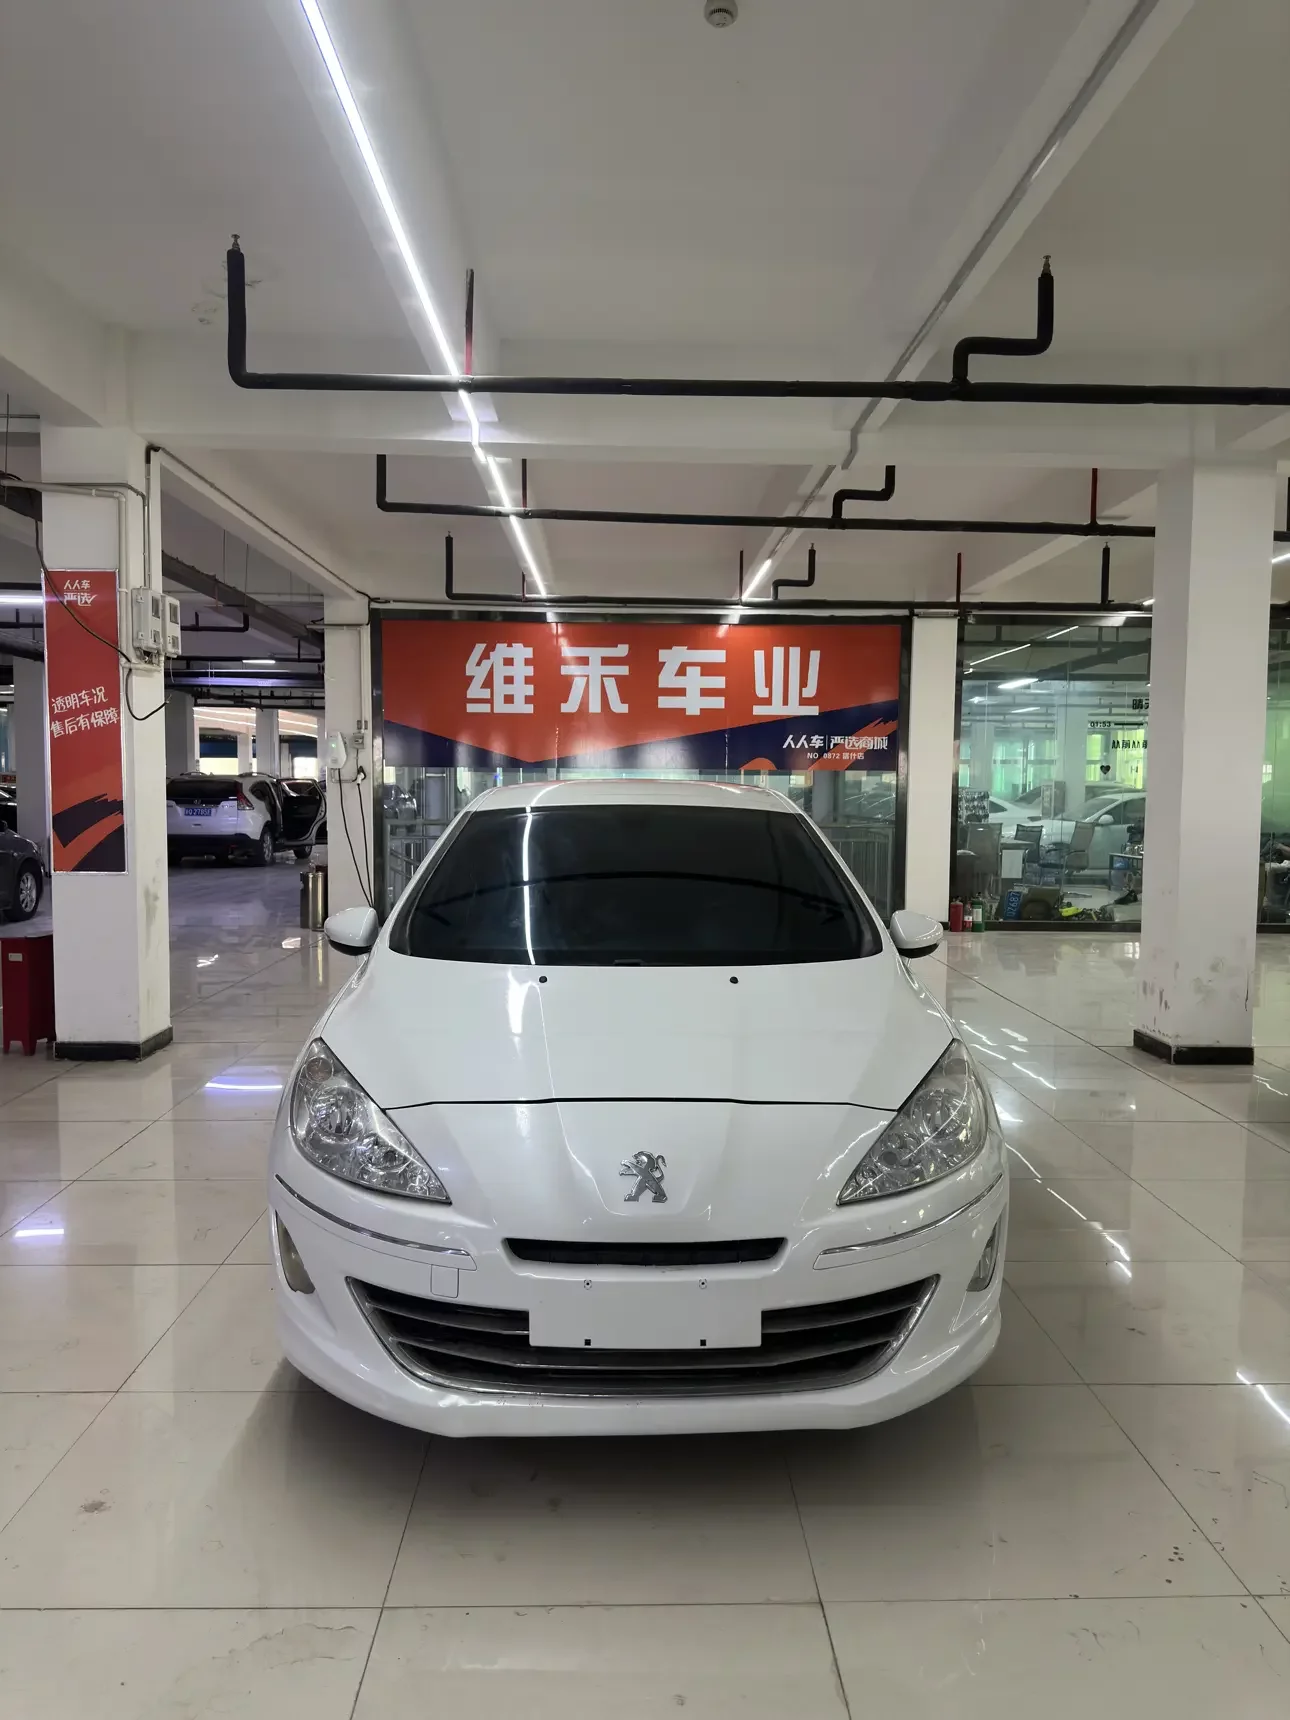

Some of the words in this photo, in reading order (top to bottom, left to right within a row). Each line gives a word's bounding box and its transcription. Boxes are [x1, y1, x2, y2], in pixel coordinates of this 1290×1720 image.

[63, 579, 91, 590] 人人车
[63, 592, 98, 607] 严选
[465, 642, 821, 717] 维禾车业
[51, 686, 109, 715] 透明车况
[50, 707, 120, 739] 售后有保障
[782, 734, 824, 749] 人人车
[829, 735, 888, 750] 严选商城
